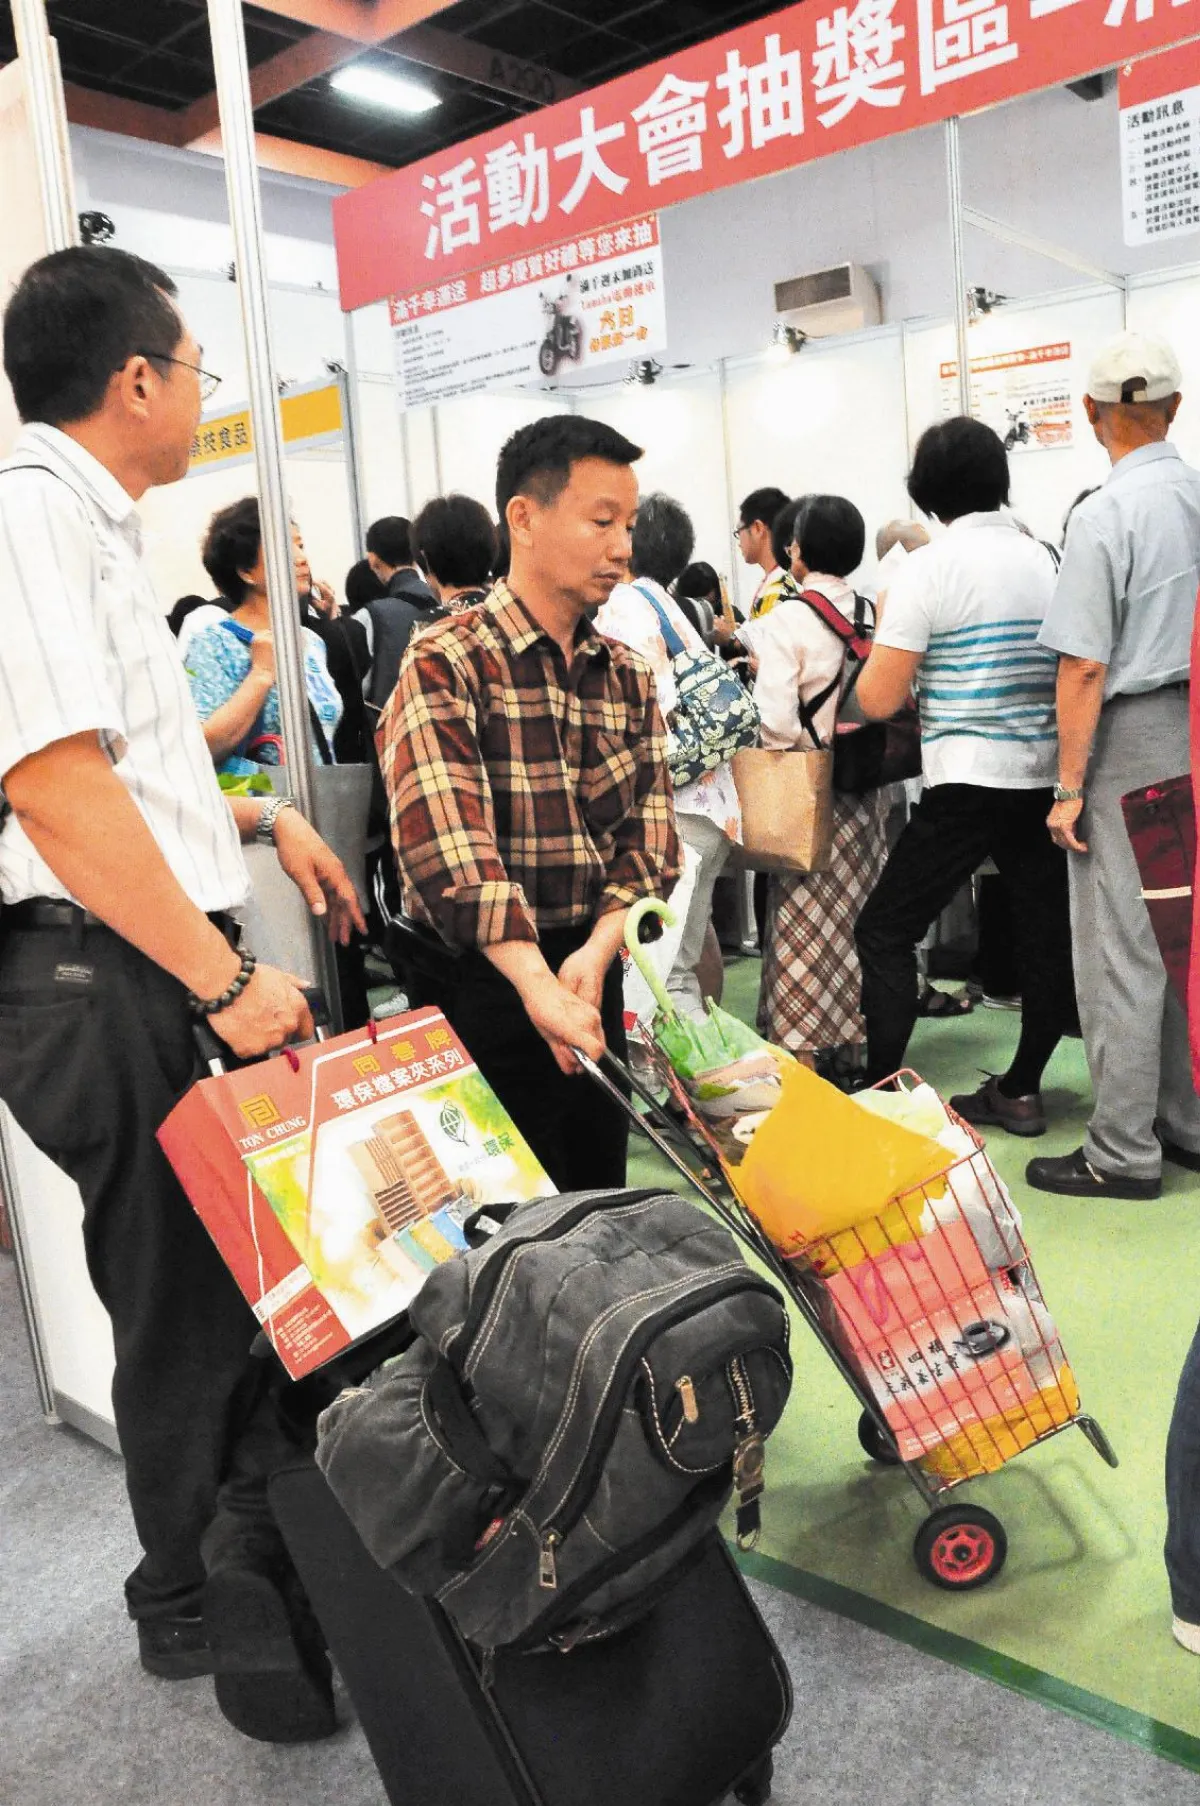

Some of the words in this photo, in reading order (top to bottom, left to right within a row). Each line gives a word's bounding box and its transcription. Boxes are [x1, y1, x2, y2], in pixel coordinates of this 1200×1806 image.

[419, 0, 1190, 260] 活動大會抽獎區
[330, 1047, 465, 1110] 環保檔案夾系列
[266, 1115, 307, 1139] CHUNG
